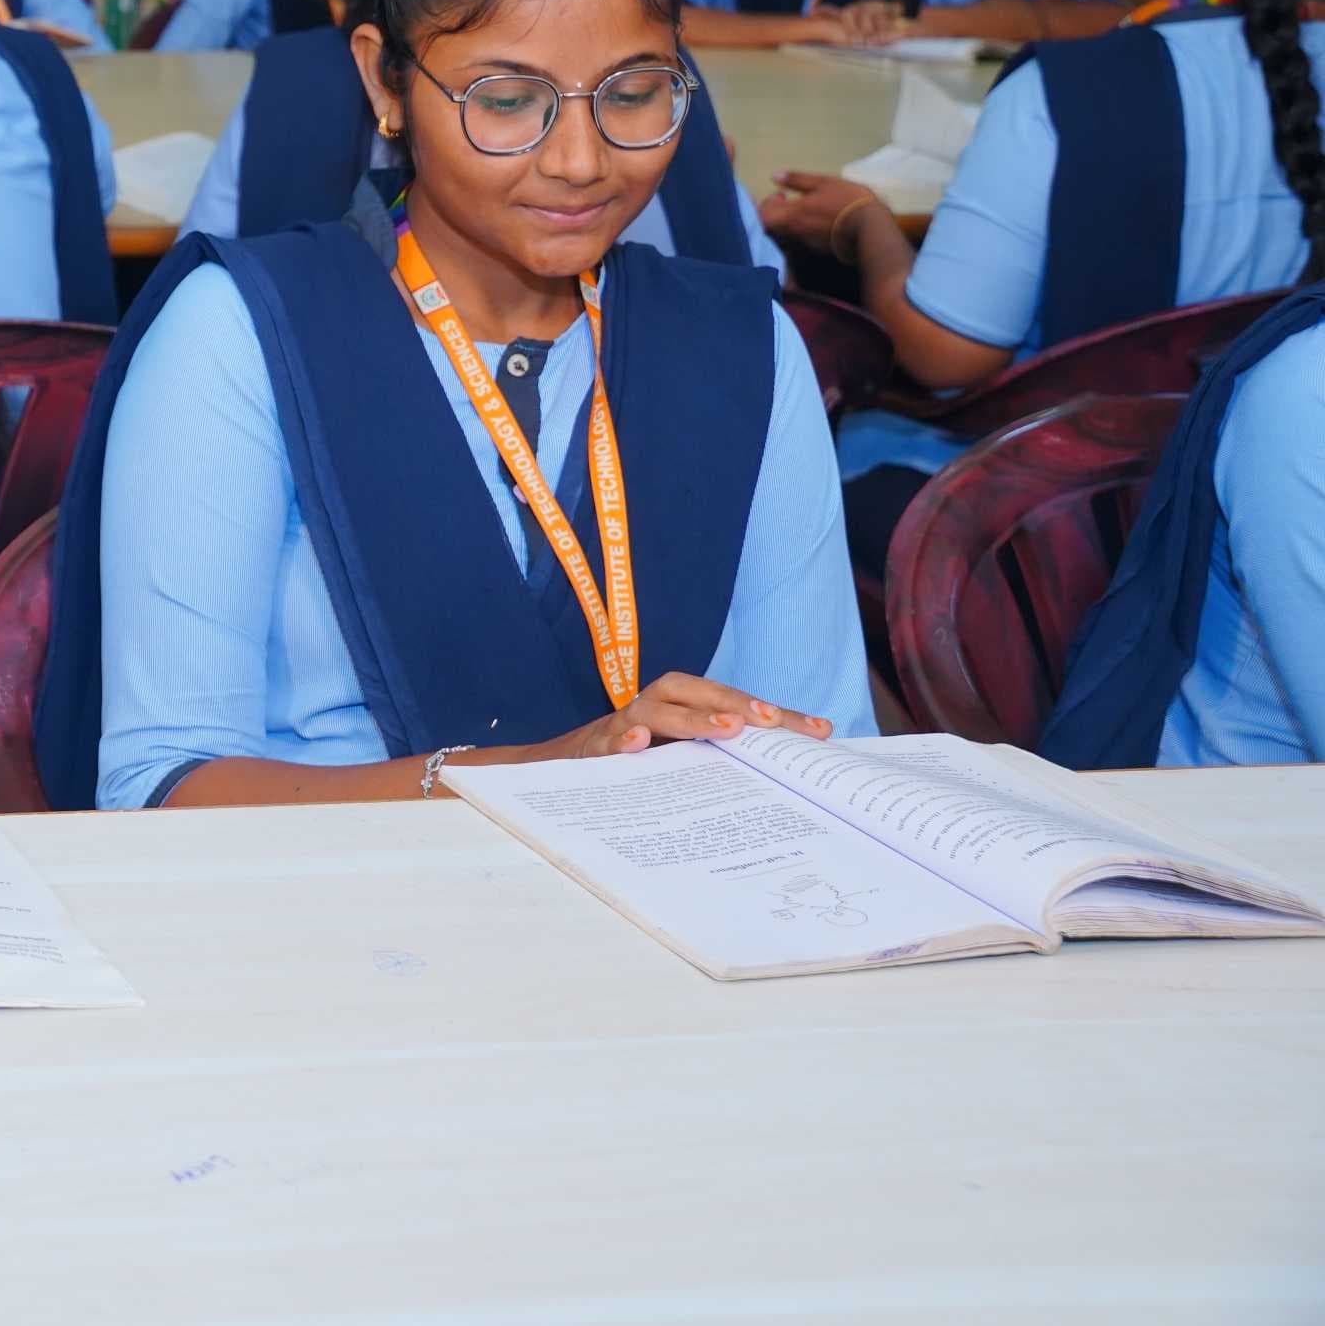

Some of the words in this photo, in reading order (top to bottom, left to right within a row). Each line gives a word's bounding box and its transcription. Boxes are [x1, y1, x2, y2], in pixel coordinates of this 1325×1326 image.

[440, 319, 491, 398] SCIENCES
[483, 397, 501, 412] &
[490, 414, 560, 526] TECHNOLOGY
[553, 528, 574, 551] OF
[605, 517, 623, 541] OF
[567, 553, 612, 646] INSTITUTE
[609, 546, 633, 641] INSTITUTE
[603, 649, 625, 695] PACE
[618, 646, 634, 690] ACE
